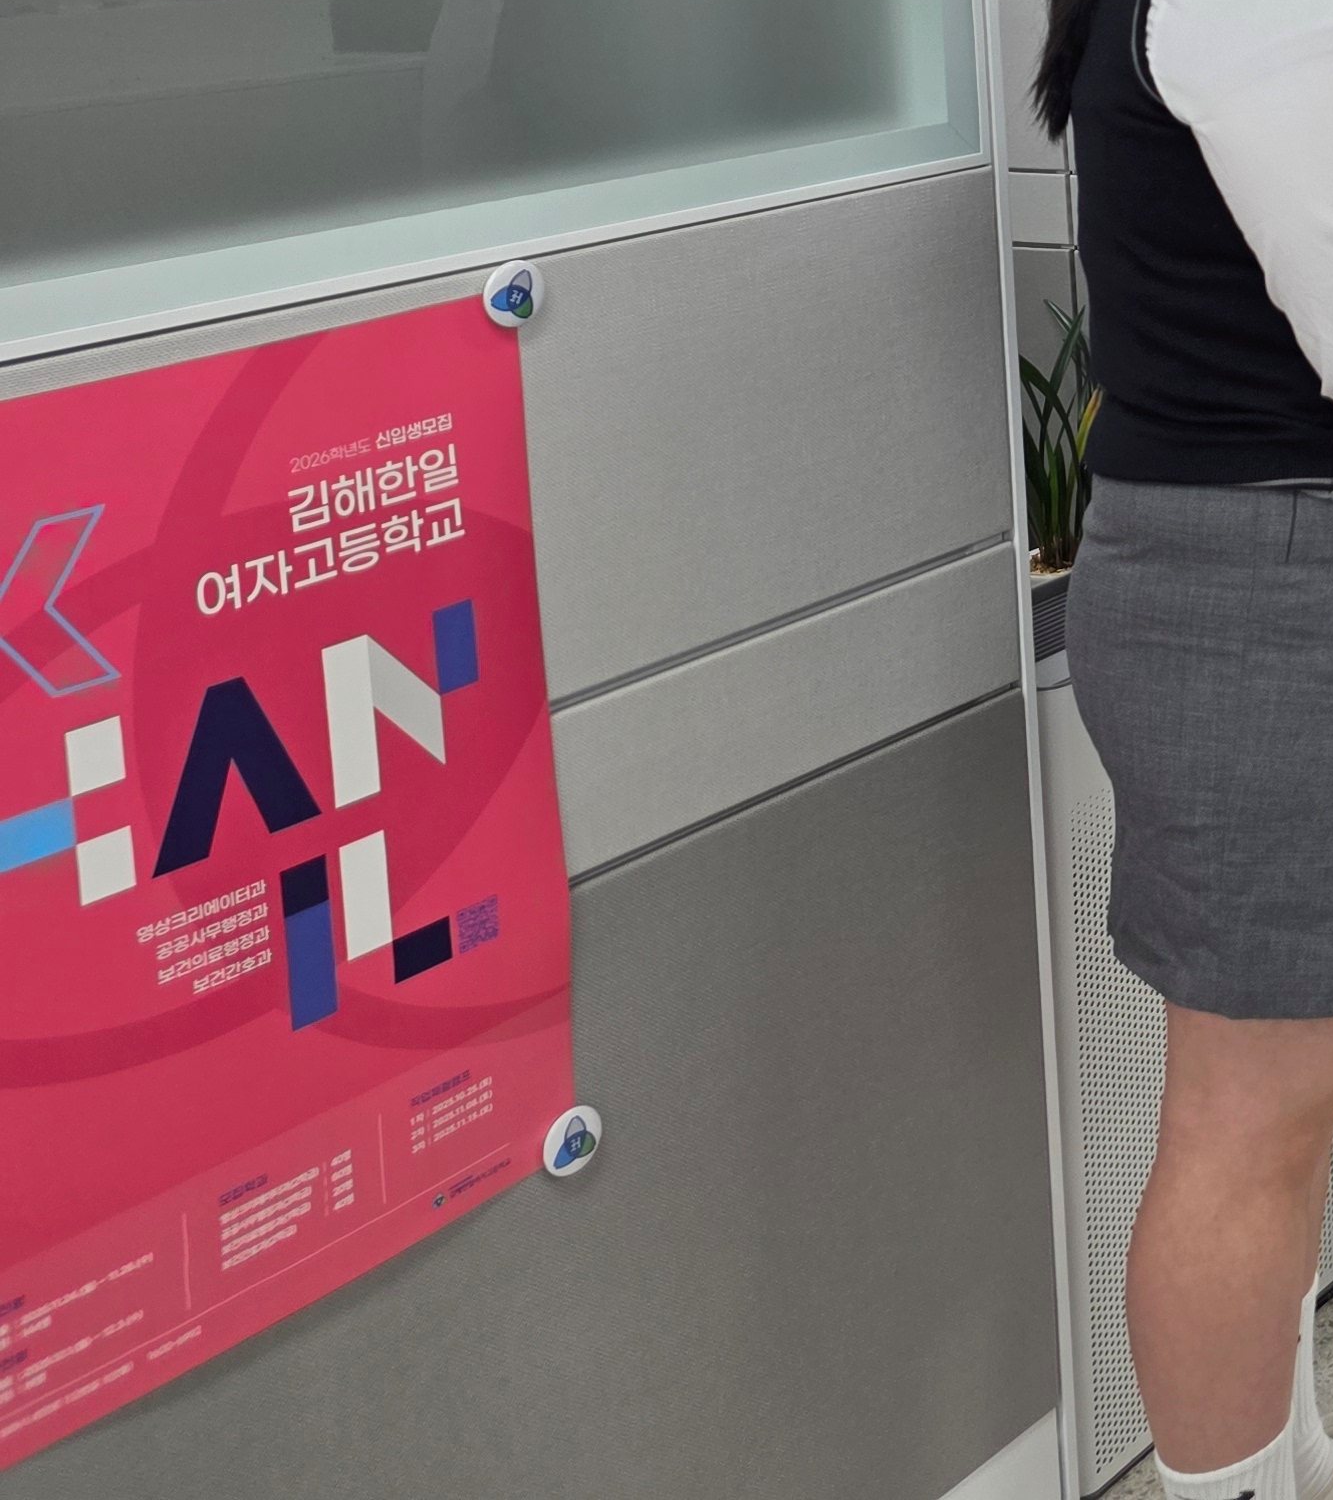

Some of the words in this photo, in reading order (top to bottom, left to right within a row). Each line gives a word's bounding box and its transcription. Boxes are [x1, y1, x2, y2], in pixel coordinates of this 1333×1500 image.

[289, 437, 371, 474] 2026학년도
[375, 412, 454, 450] 신입생모집
[287, 443, 459, 533] 김해한일
[195, 497, 466, 615] 여자고등학교
[136, 879, 267, 943] 영상크리에이터과
[156, 902, 268, 961] 공공사무행정과
[157, 925, 270, 985] 보건의료행정과
[193, 948, 272, 994] 보건간호과
